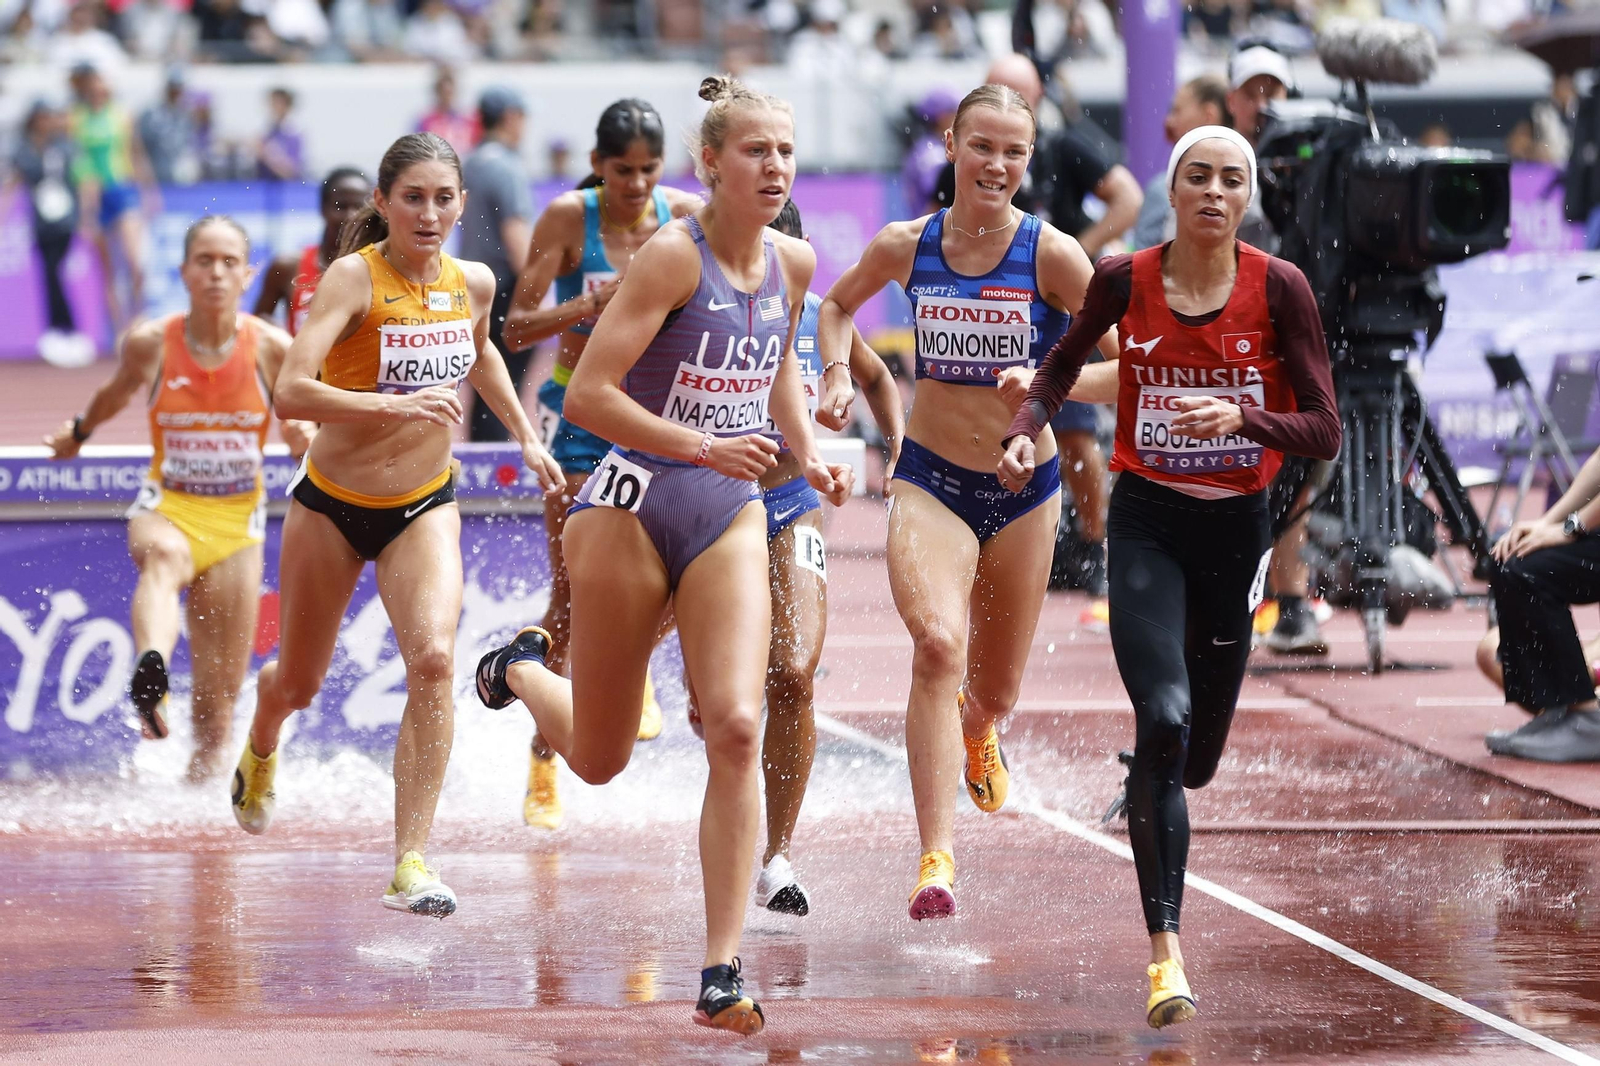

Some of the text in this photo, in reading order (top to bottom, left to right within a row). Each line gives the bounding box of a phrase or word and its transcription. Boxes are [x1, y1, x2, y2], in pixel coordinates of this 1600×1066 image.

[430, 297, 449, 306] WGV
[911, 286, 947, 296] CRAFT
[982, 290, 1032, 301] motonet
[918, 304, 1028, 325] HONDA
[384, 328, 471, 349] HONDA
[922, 330, 1024, 358] MONONEN
[696, 331, 781, 371] USA
[386, 354, 471, 382] KRAUSE
[1131, 364, 1264, 387] TUNISIA
[676, 370, 772, 394] HONDA
[669, 395, 765, 430] NAPOLEON
[600, 464, 641, 510] 10
[802, 534, 825, 572] 13
